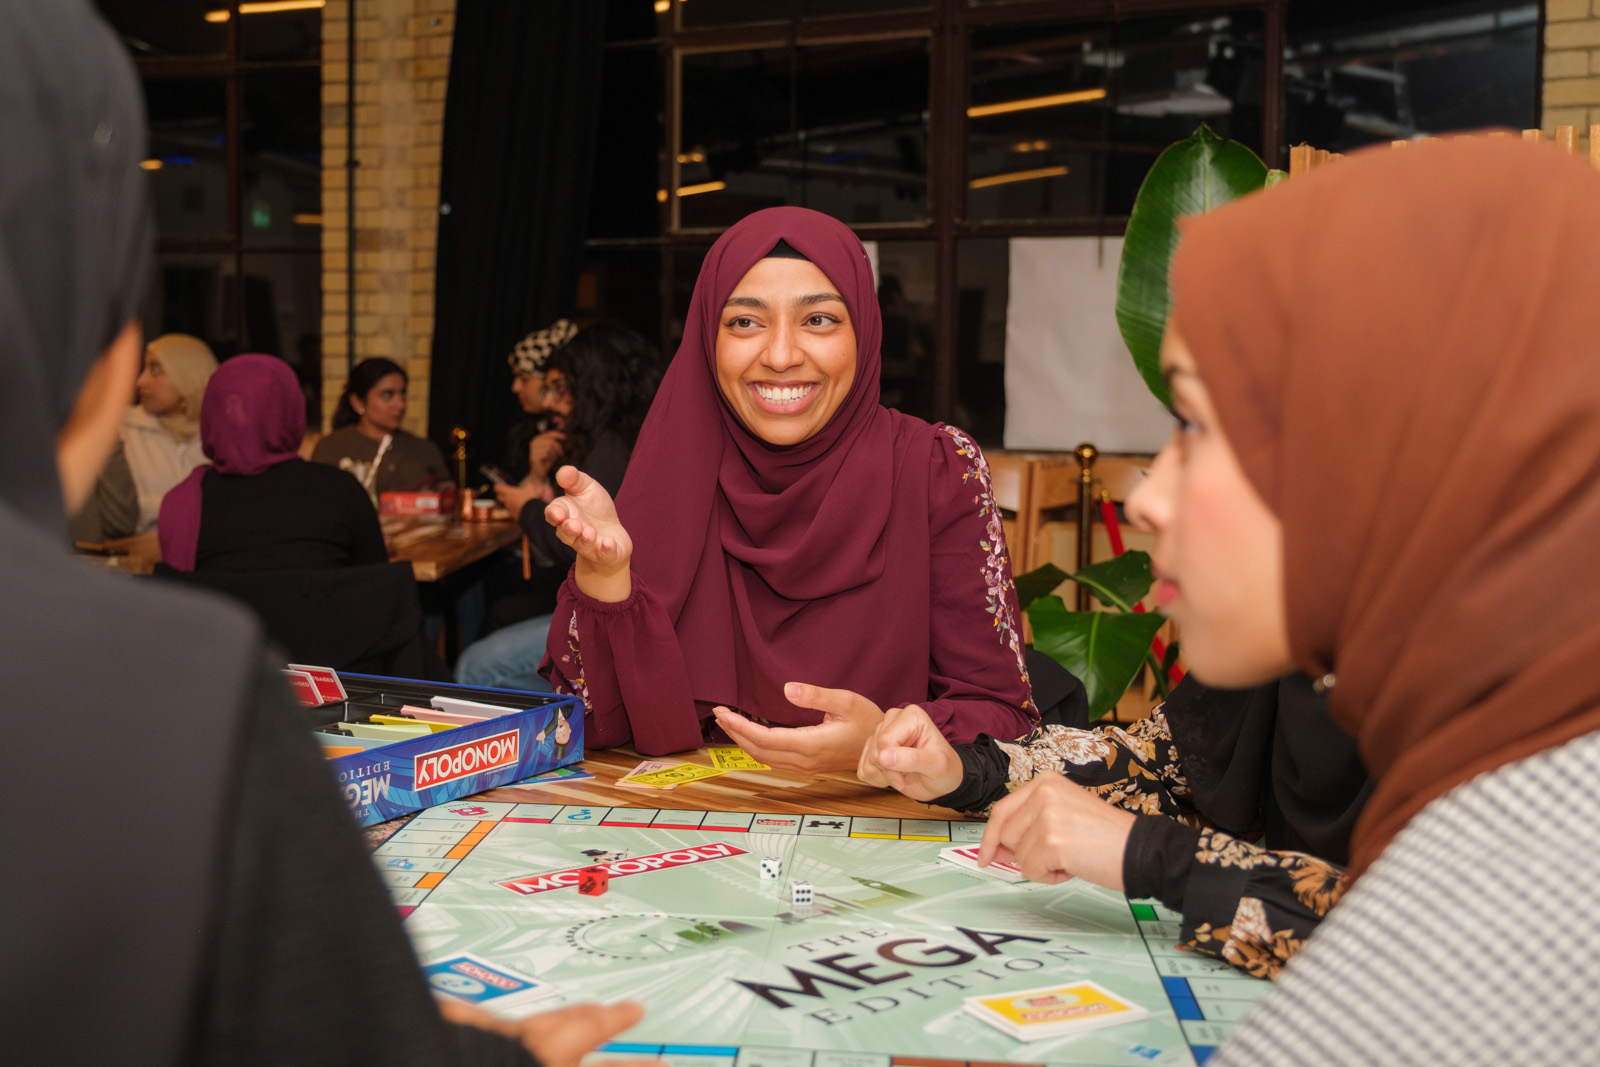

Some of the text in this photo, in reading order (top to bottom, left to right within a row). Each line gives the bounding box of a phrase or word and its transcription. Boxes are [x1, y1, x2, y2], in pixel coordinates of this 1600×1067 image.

[338, 760, 391, 783] EDITIO
[417, 735, 517, 785] MONOPOLY
[343, 773, 391, 809] MEG
[787, 928, 888, 953] THE
[728, 925, 1052, 1010] MEGA
[805, 944, 1090, 1026] EDITION
